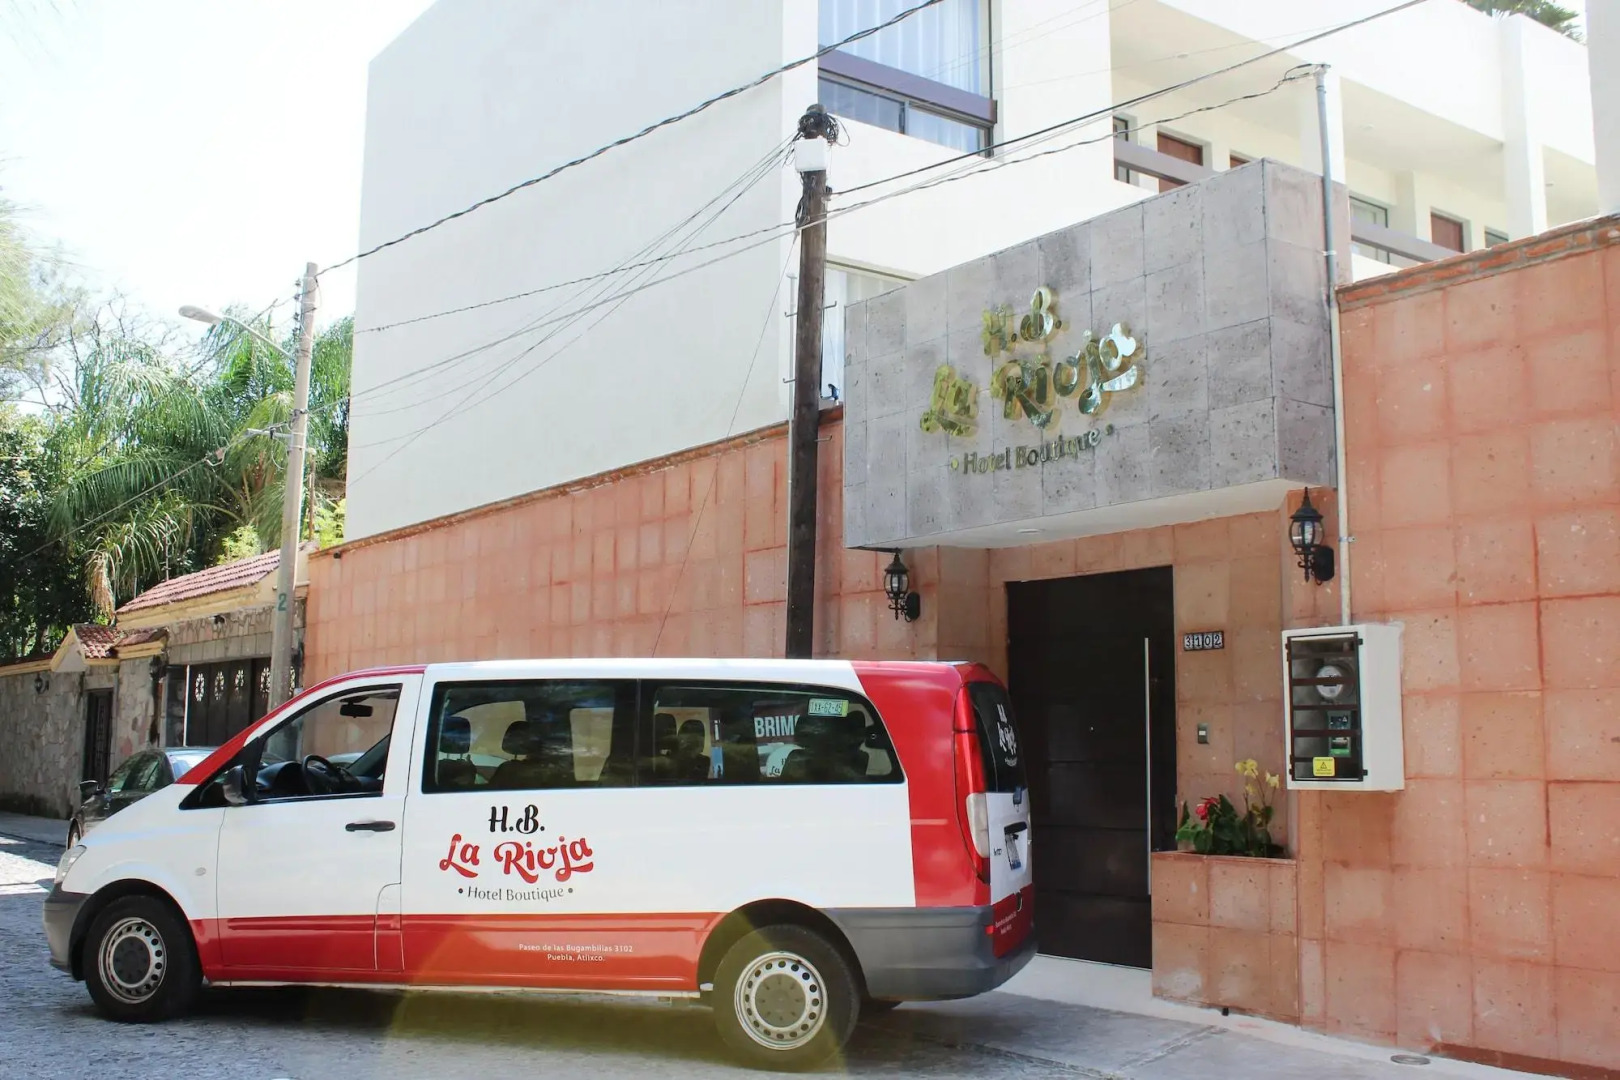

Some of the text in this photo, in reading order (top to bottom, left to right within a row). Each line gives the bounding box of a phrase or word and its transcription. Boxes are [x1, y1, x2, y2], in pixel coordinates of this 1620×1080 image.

[990, 322, 1138, 429] Rioja
[963, 428, 1101, 475] Hotel Boutique
[278, 593, 286, 611] 2
[1185, 633, 1222, 648] 3102
[488, 804, 545, 834] H.B.
[439, 833, 594, 884] La Rioja
[467, 886, 564, 902] Hotel Boutique
[519, 944, 541, 952] Paseo
[542, 944, 552, 952] de
[553, 944, 565, 952] las
[615, 945, 633, 953] 3102
[547, 954, 575, 962] Puebla,
